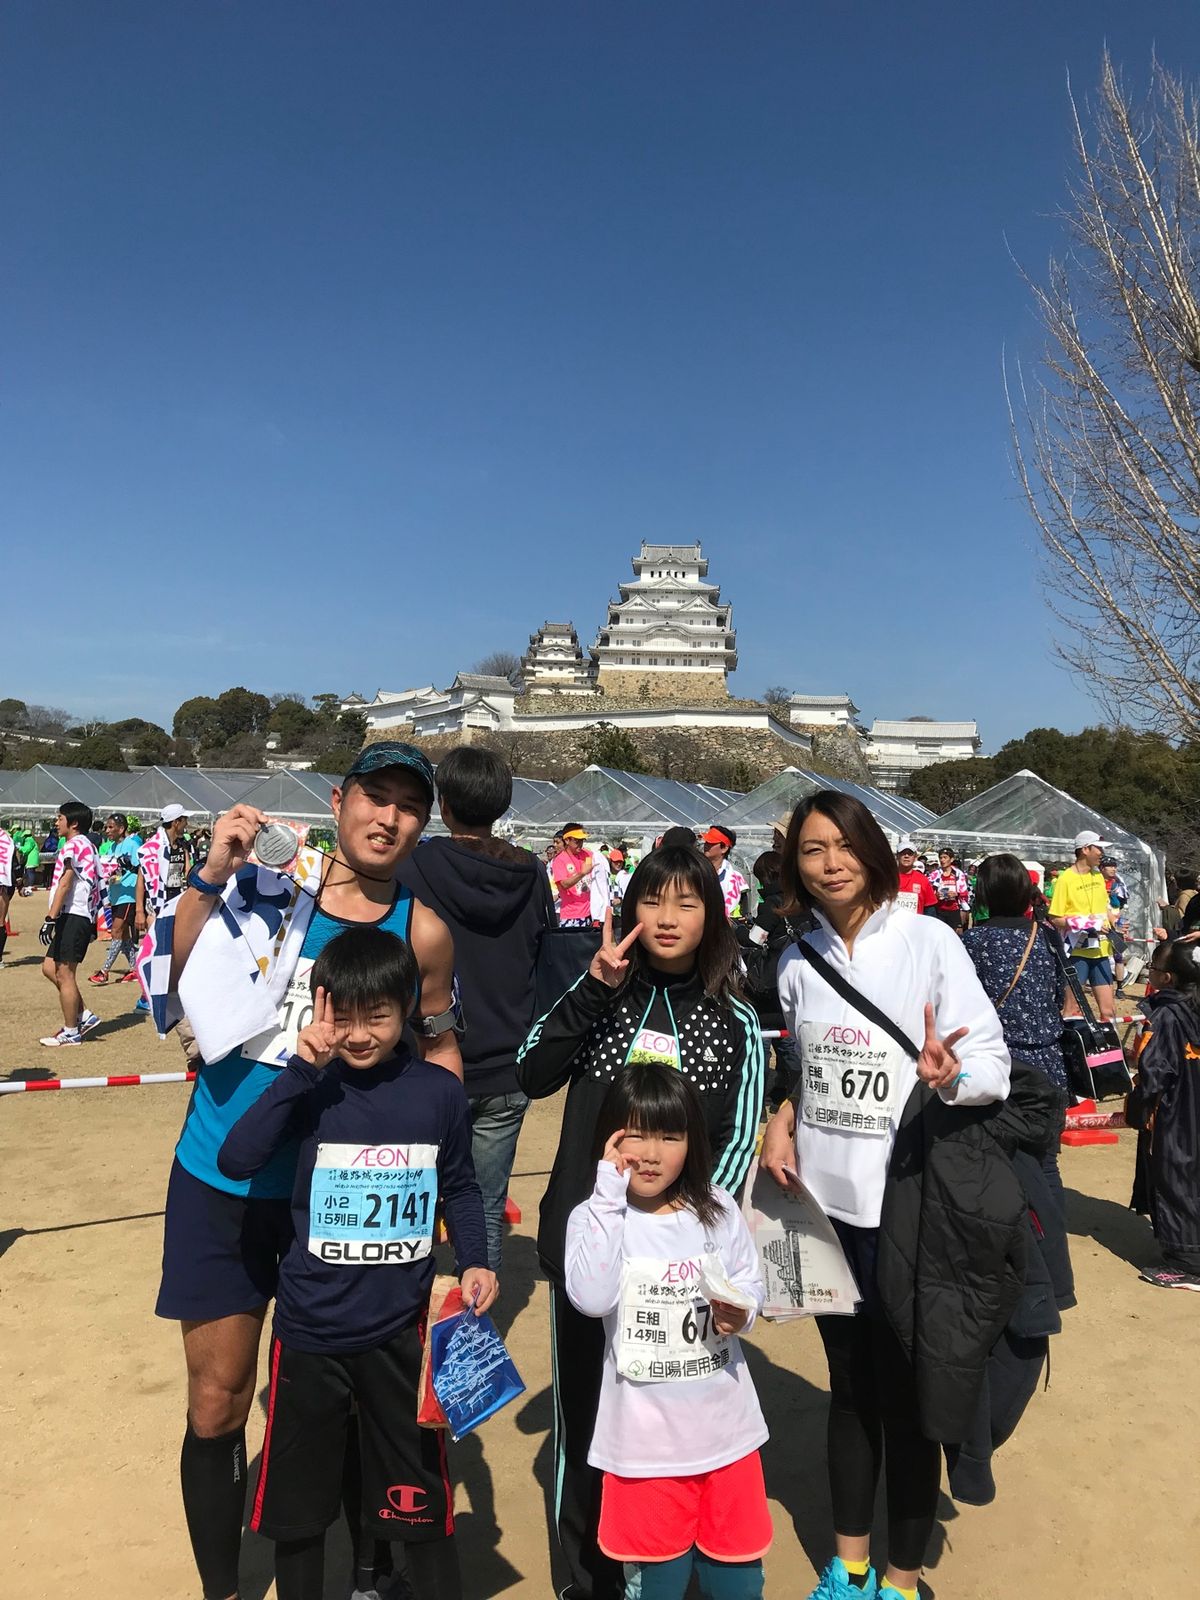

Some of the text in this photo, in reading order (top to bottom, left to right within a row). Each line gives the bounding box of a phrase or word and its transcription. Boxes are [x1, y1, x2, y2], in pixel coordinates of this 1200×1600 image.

[808, 1065, 823, 1079] E組
[841, 1068, 890, 1103] 670
[815, 1106, 892, 1131] 但陽信用金庫
[324, 1195, 350, 1209] 小2
[363, 1191, 430, 1229] 2141
[316, 1213, 358, 1227] 15列目
[320, 1240, 422, 1261] GLORY
[636, 1310, 660, 1326] E組
[626, 1327, 667, 1344] 14列目
[648, 1348, 729, 1378] 但陽信用金庫
[378, 1508, 434, 1526] Champion
